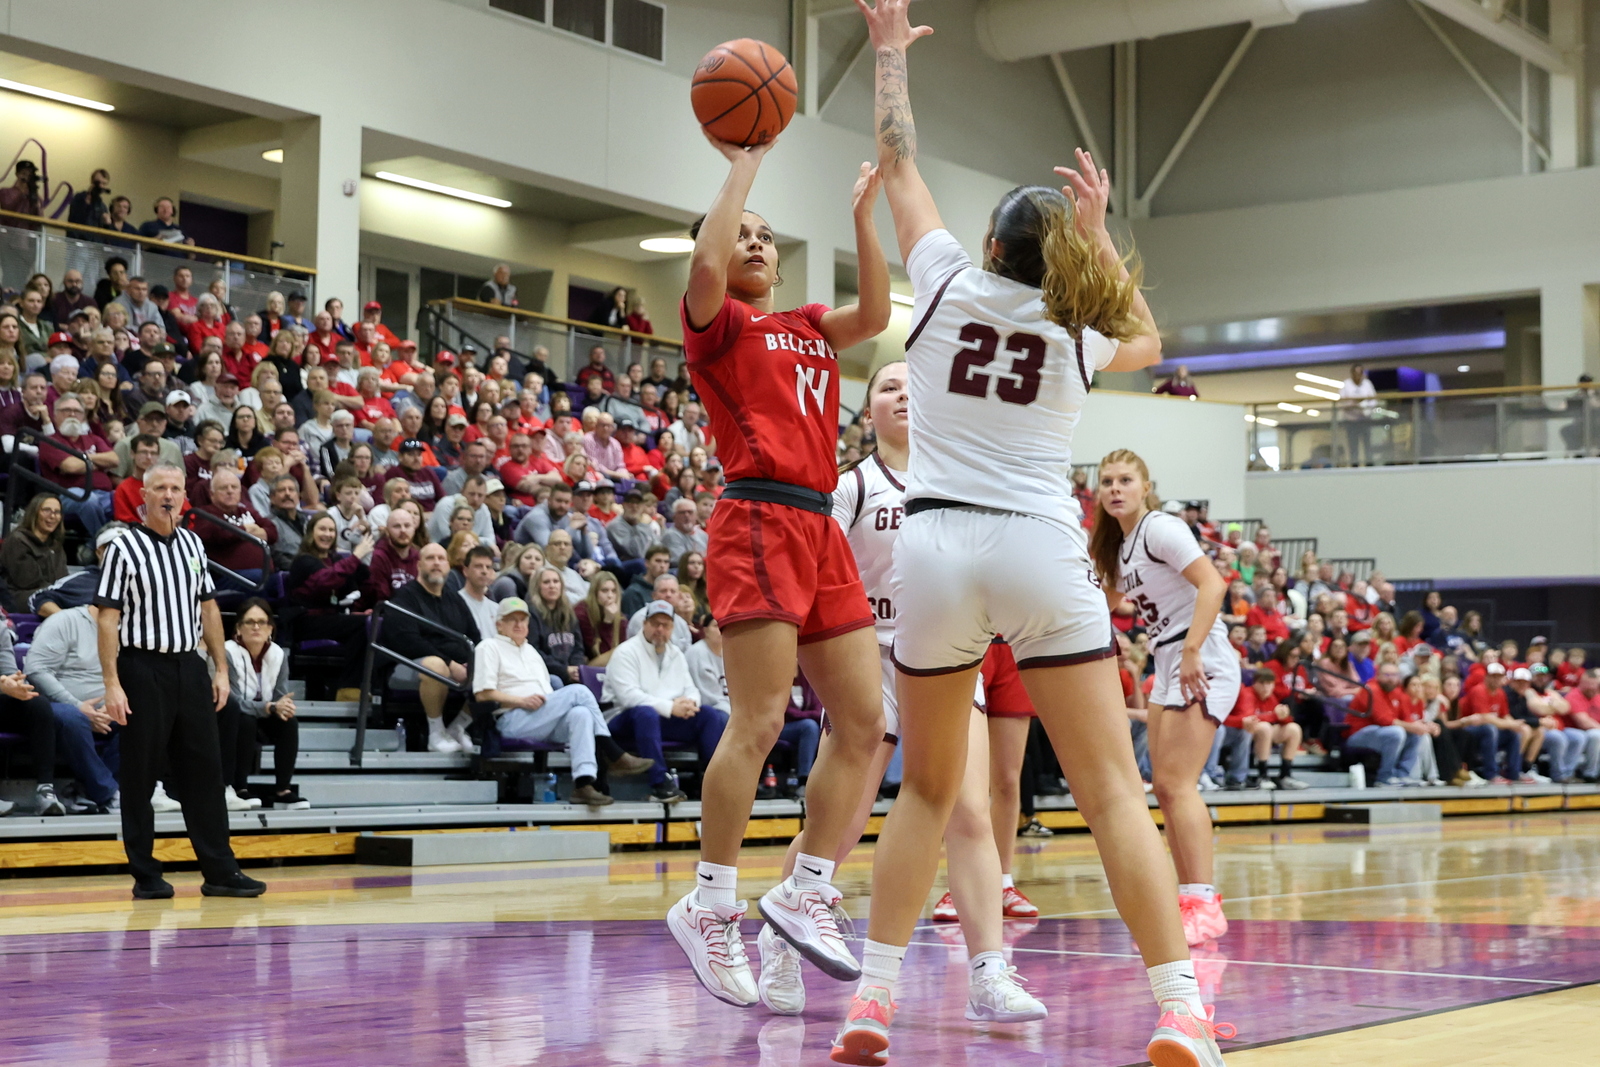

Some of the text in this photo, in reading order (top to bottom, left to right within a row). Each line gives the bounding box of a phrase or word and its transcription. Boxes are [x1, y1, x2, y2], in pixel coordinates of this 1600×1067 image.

[765, 333, 836, 360] BELLEVU
[948, 321, 1047, 406] 23
[795, 363, 830, 416] 14
